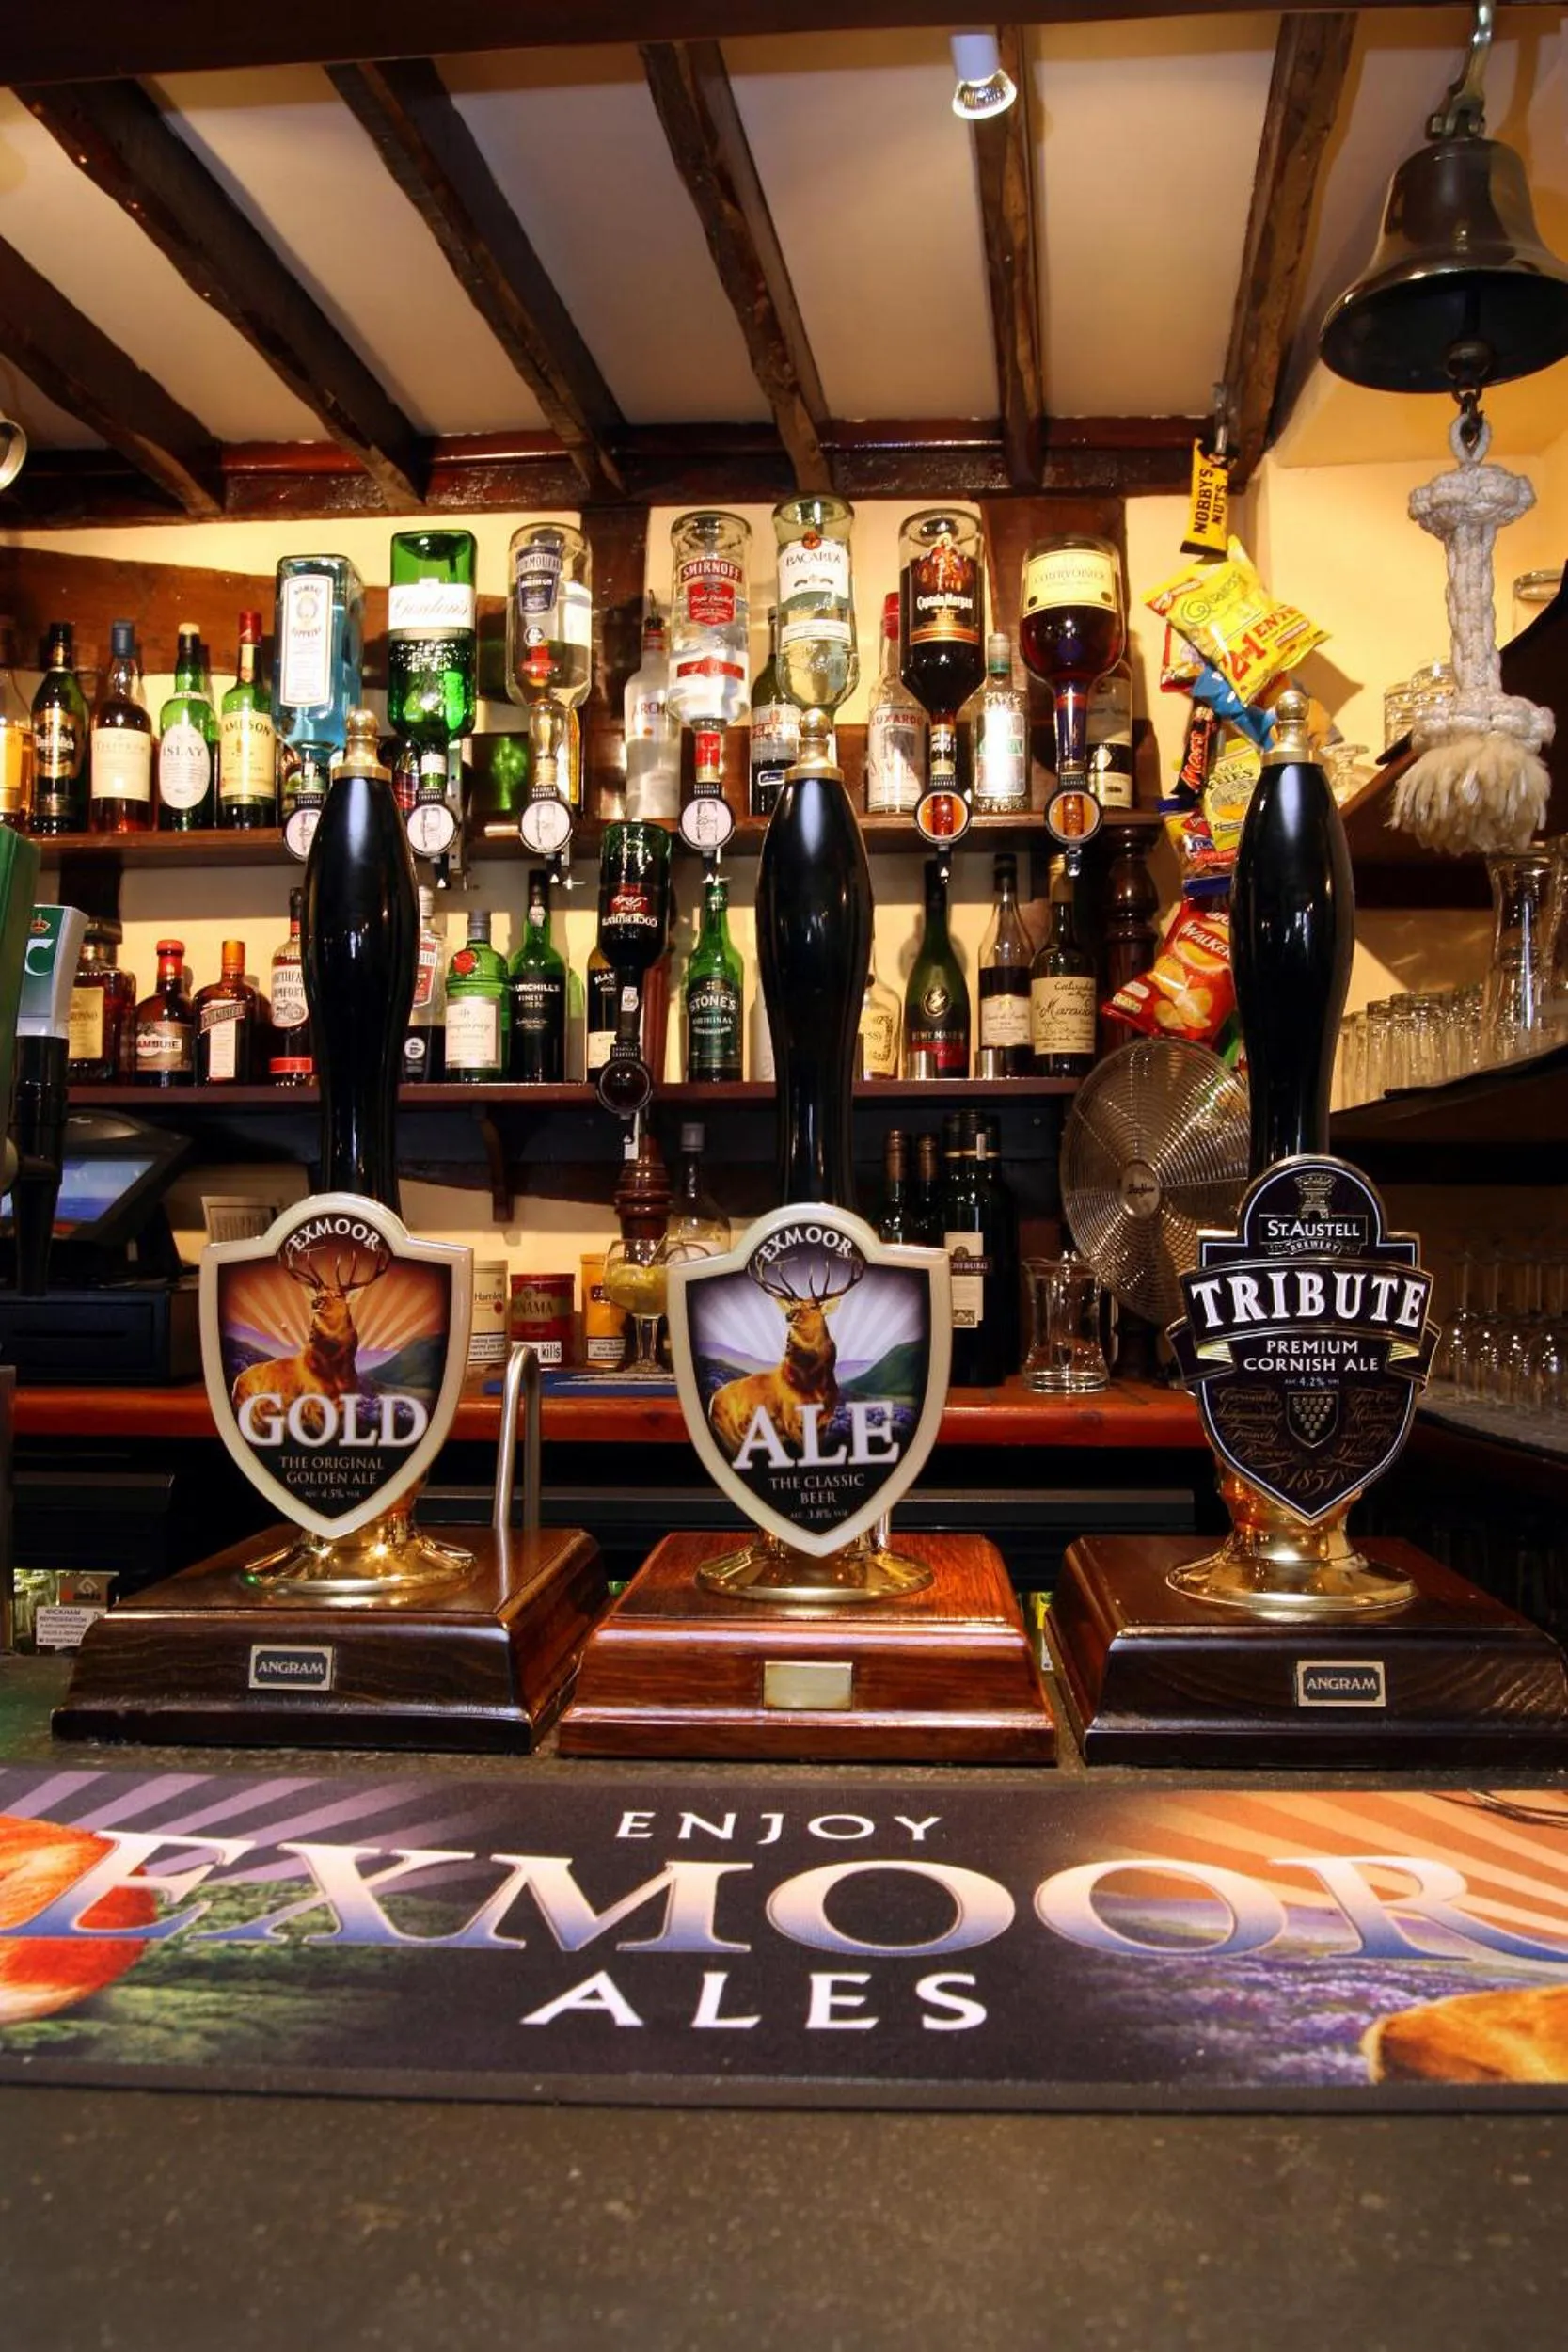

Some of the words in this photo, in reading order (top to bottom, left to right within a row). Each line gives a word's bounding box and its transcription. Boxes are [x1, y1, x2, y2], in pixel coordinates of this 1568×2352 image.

[1193, 469, 1214, 534] NOBBYS
[1212, 485, 1227, 524] NUTS
[785, 551, 842, 566] BACARDI
[682, 561, 742, 582] SMIRNOFF
[916, 595, 944, 610] Captain
[944, 594, 973, 609] Morgan
[225, 718, 270, 736] JAMSON
[163, 745, 203, 757] ISLAY
[1181, 920, 1230, 960] WALKER
[293, 1218, 381, 1252] EXMOOR
[759, 1226, 853, 1262] EXMOOR
[1290, 1239, 1338, 1253] BREWERY
[474, 1291, 504, 1301] Hamlet
[1190, 1271, 1426, 1329] TRIBUTE
[515, 1300, 554, 1315] NAMA
[541, 1343, 562, 1359] kills
[1266, 1340, 1358, 1355] PREMIUM
[1243, 1357, 1336, 1372] CORNISH
[1344, 1357, 1379, 1372] ALE
[1299, 1376, 1325, 1388] 4.2%
[238, 1393, 428, 1447] GOLD
[732, 1400, 900, 1470] ALE
[280, 1456, 308, 1470] THE
[311, 1456, 384, 1470] ORIGINAL
[286, 1471, 347, 1485] GOLDEN
[352, 1471, 377, 1485] ALE
[769, 1476, 800, 1490] THE
[804, 1473, 865, 1488] CLASSIC
[1286, 1469, 1338, 1498] 1851
[800, 1491, 837, 1505] BEER
[258, 1661, 325, 1675] ANGRAM
[1307, 1677, 1377, 1691] ANGRAM
[616, 1810, 942, 1842] ENJOY
[0, 1829, 1568, 1963] EXMOOR
[519, 1969, 988, 2033] ALES
